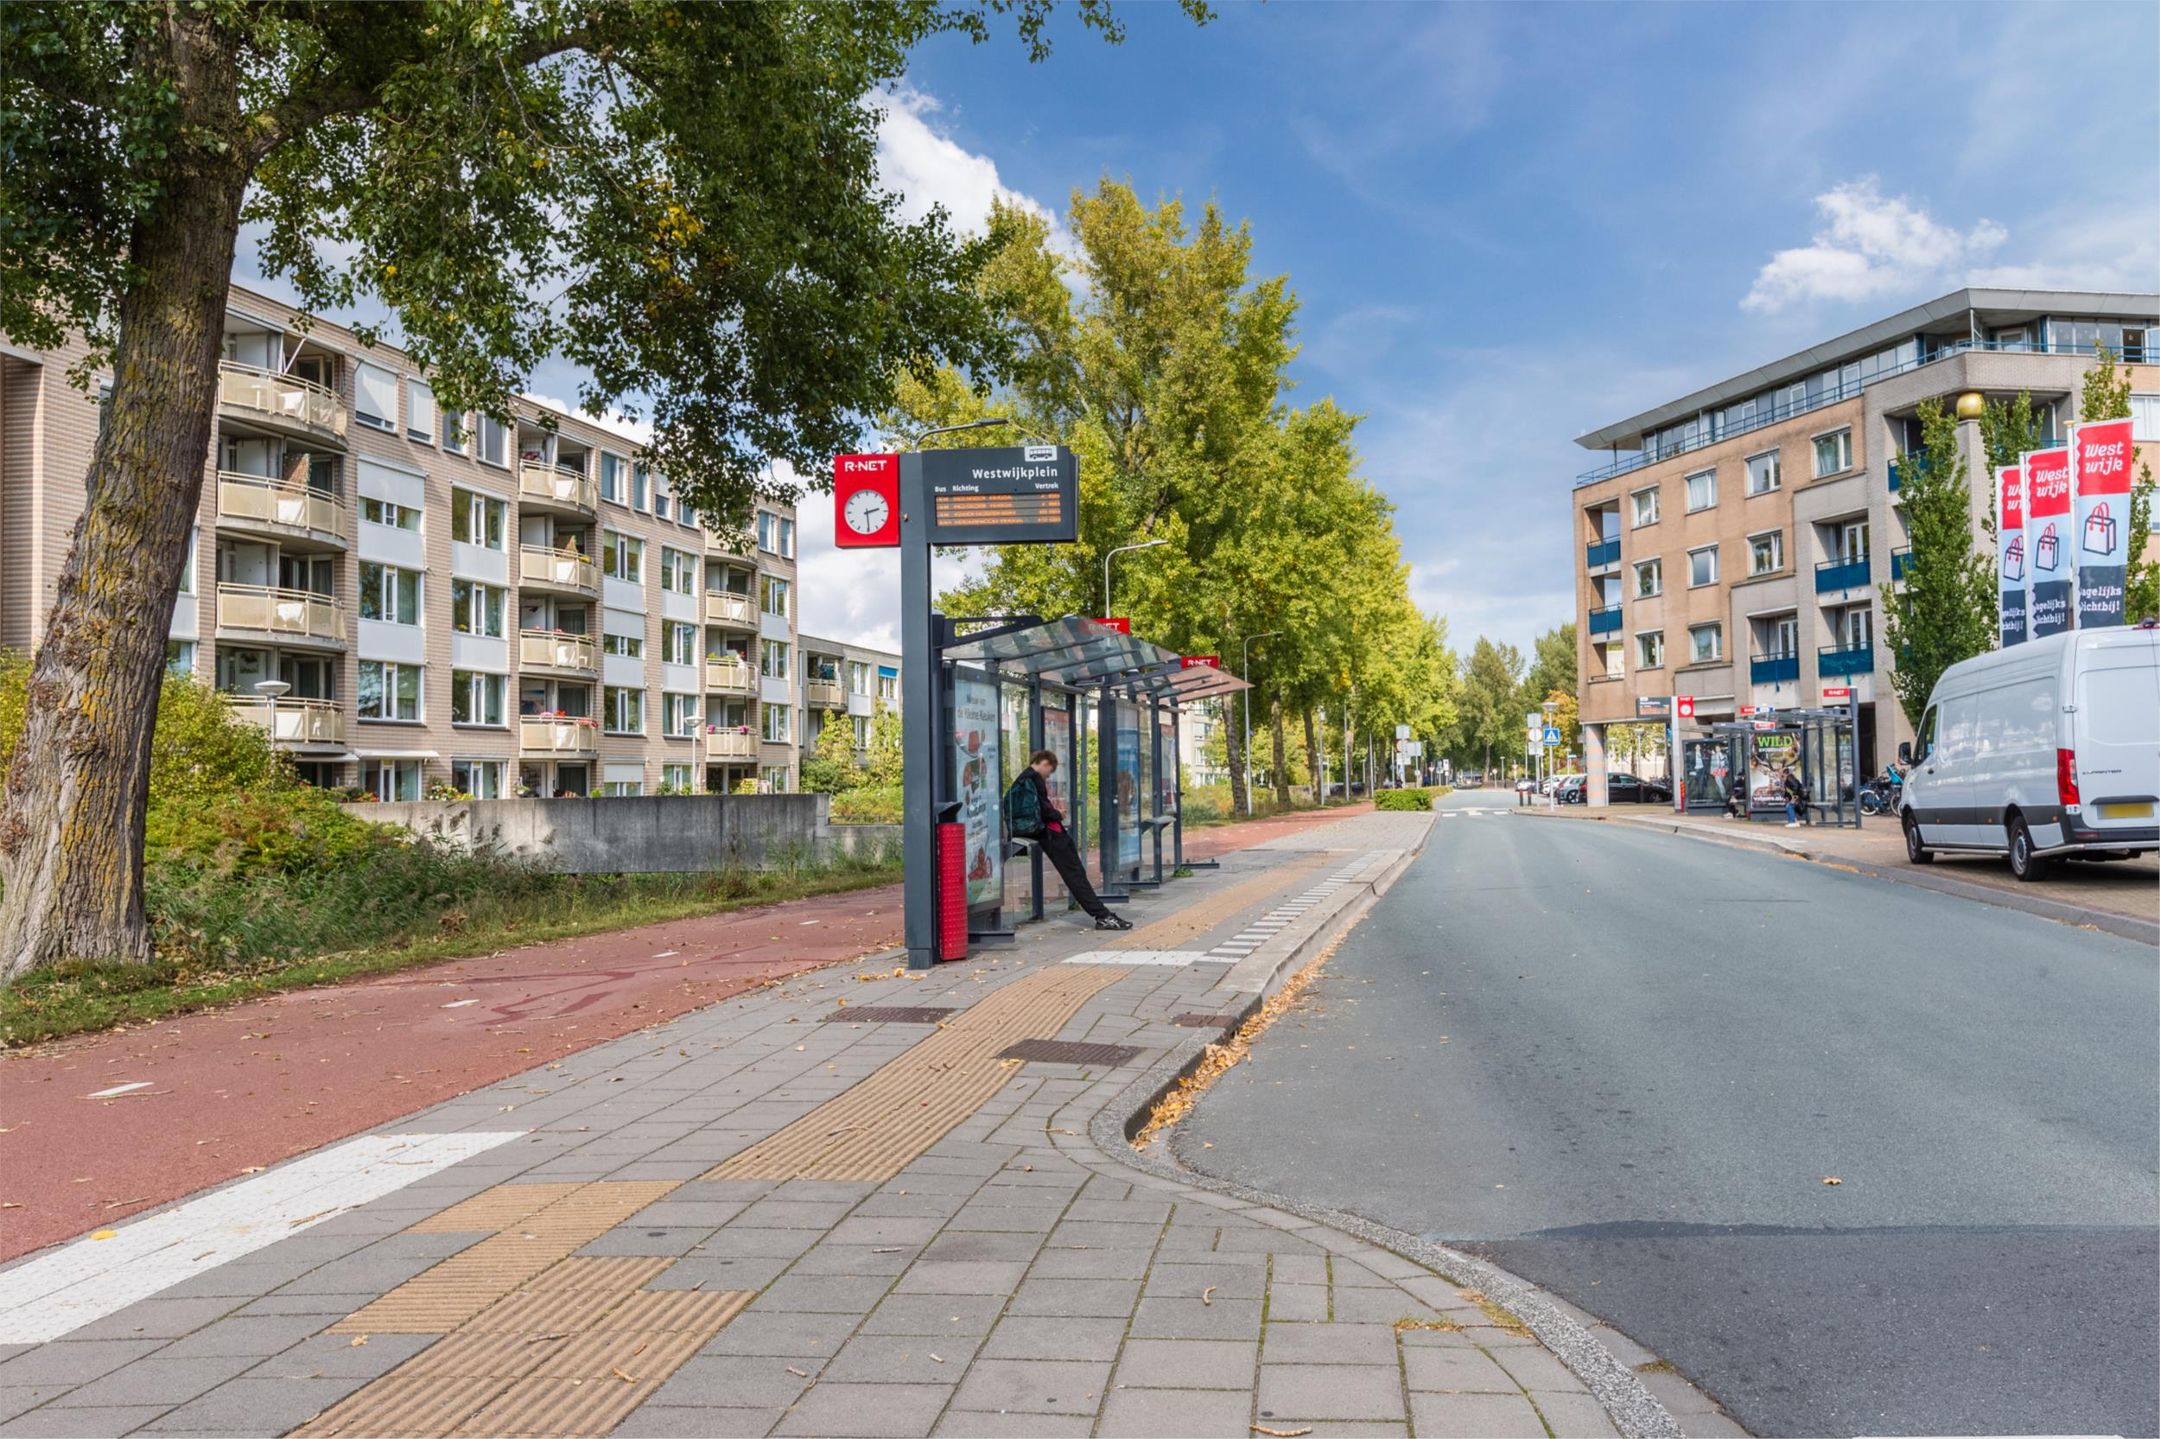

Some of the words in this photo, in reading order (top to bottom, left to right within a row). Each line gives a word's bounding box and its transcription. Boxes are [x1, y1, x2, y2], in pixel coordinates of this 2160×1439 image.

[2084, 441, 2124, 458] West
[972, 466, 1058, 480] Westwijkplein
[2085, 456, 2124, 475] wijk
[2036, 466, 2070, 483] West
[952, 484, 979, 493] Richting
[1034, 482, 1059, 490] Vertrek
[2036, 481, 2068, 498] wijk
[1757, 735, 1793, 747] WILD
